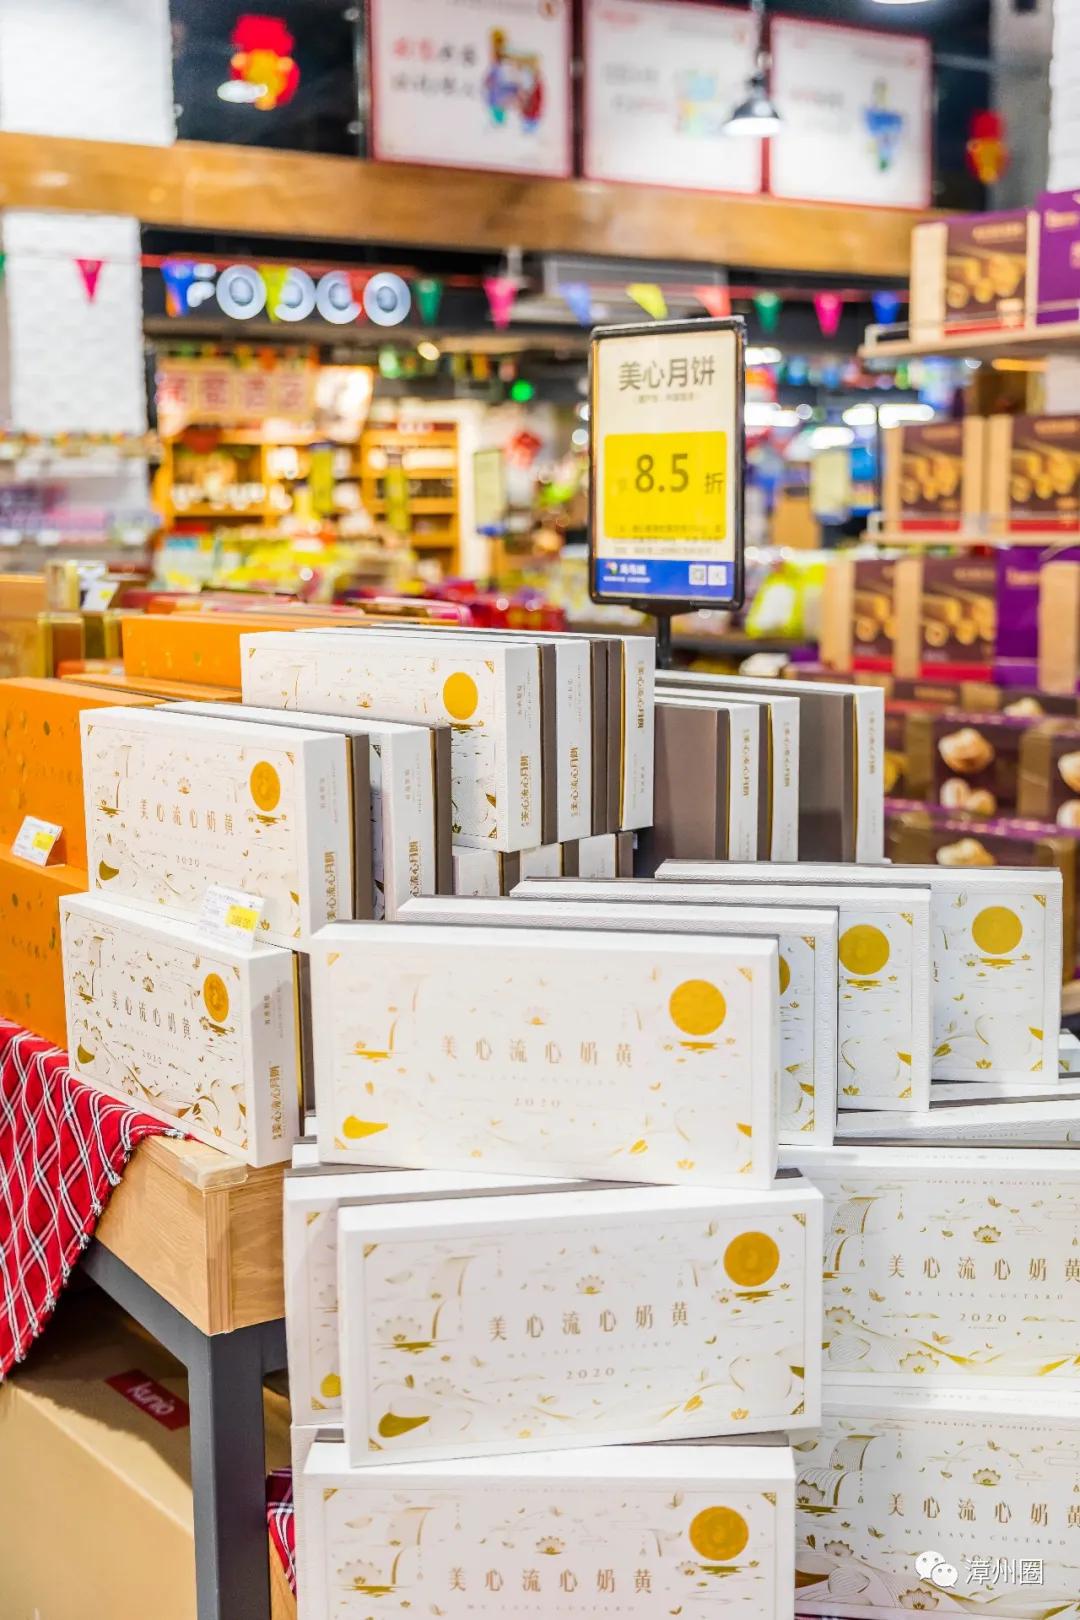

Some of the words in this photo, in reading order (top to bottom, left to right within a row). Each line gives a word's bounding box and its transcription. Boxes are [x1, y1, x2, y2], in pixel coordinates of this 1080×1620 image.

[618, 356, 715, 391] 美心月饼
[636, 454, 689, 492] 8.5
[489, 1302, 689, 1341] 美心流心奶黄
[960, 1313, 1006, 1322] 2020
[567, 1368, 615, 1380] 2020
[449, 1567, 652, 1593] 美心流心奶黄
